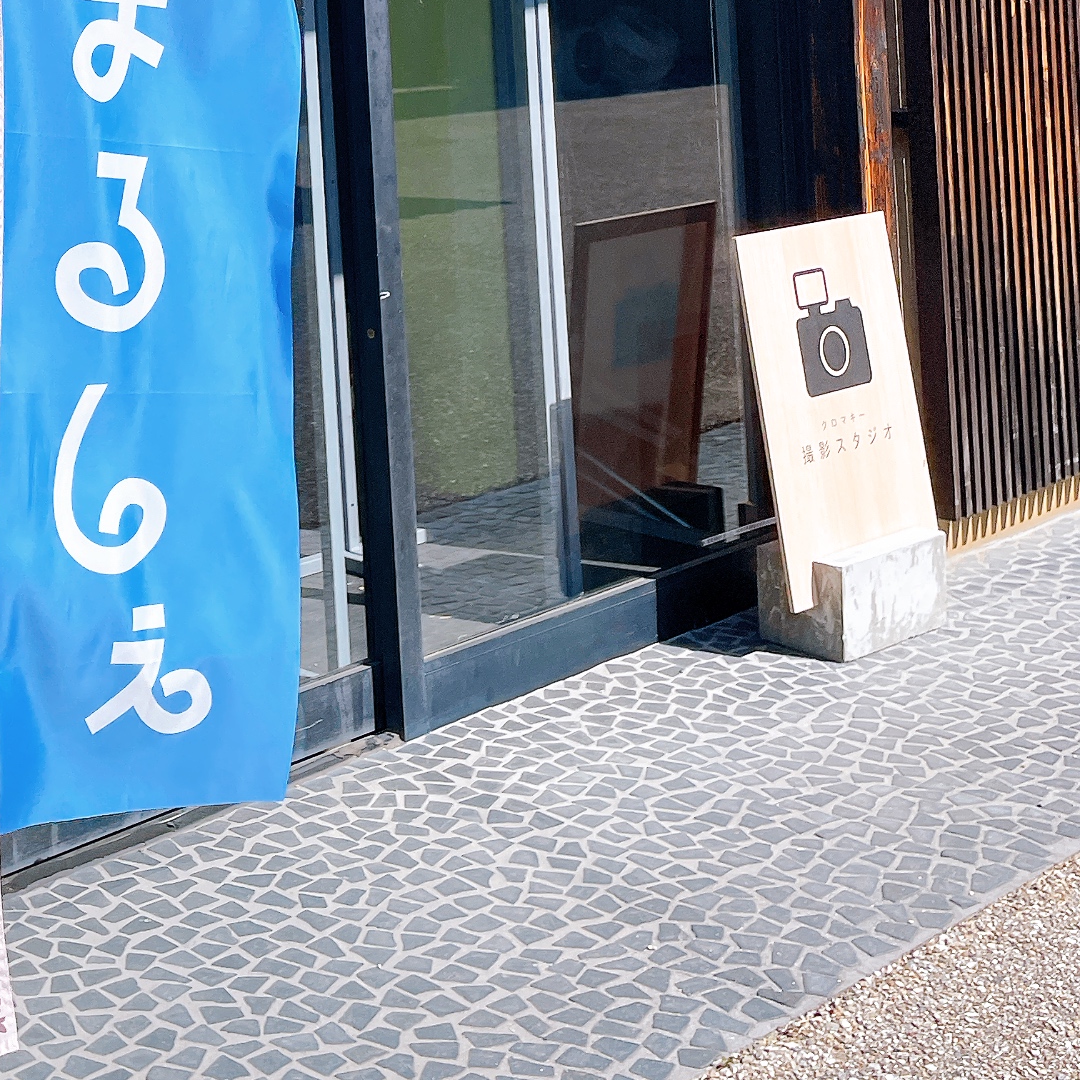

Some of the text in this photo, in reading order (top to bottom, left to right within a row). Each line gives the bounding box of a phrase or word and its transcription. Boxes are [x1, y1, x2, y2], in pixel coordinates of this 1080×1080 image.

[821, 412, 866, 431] クロマキー
[801, 422, 892, 465] 撮影スタジオ
